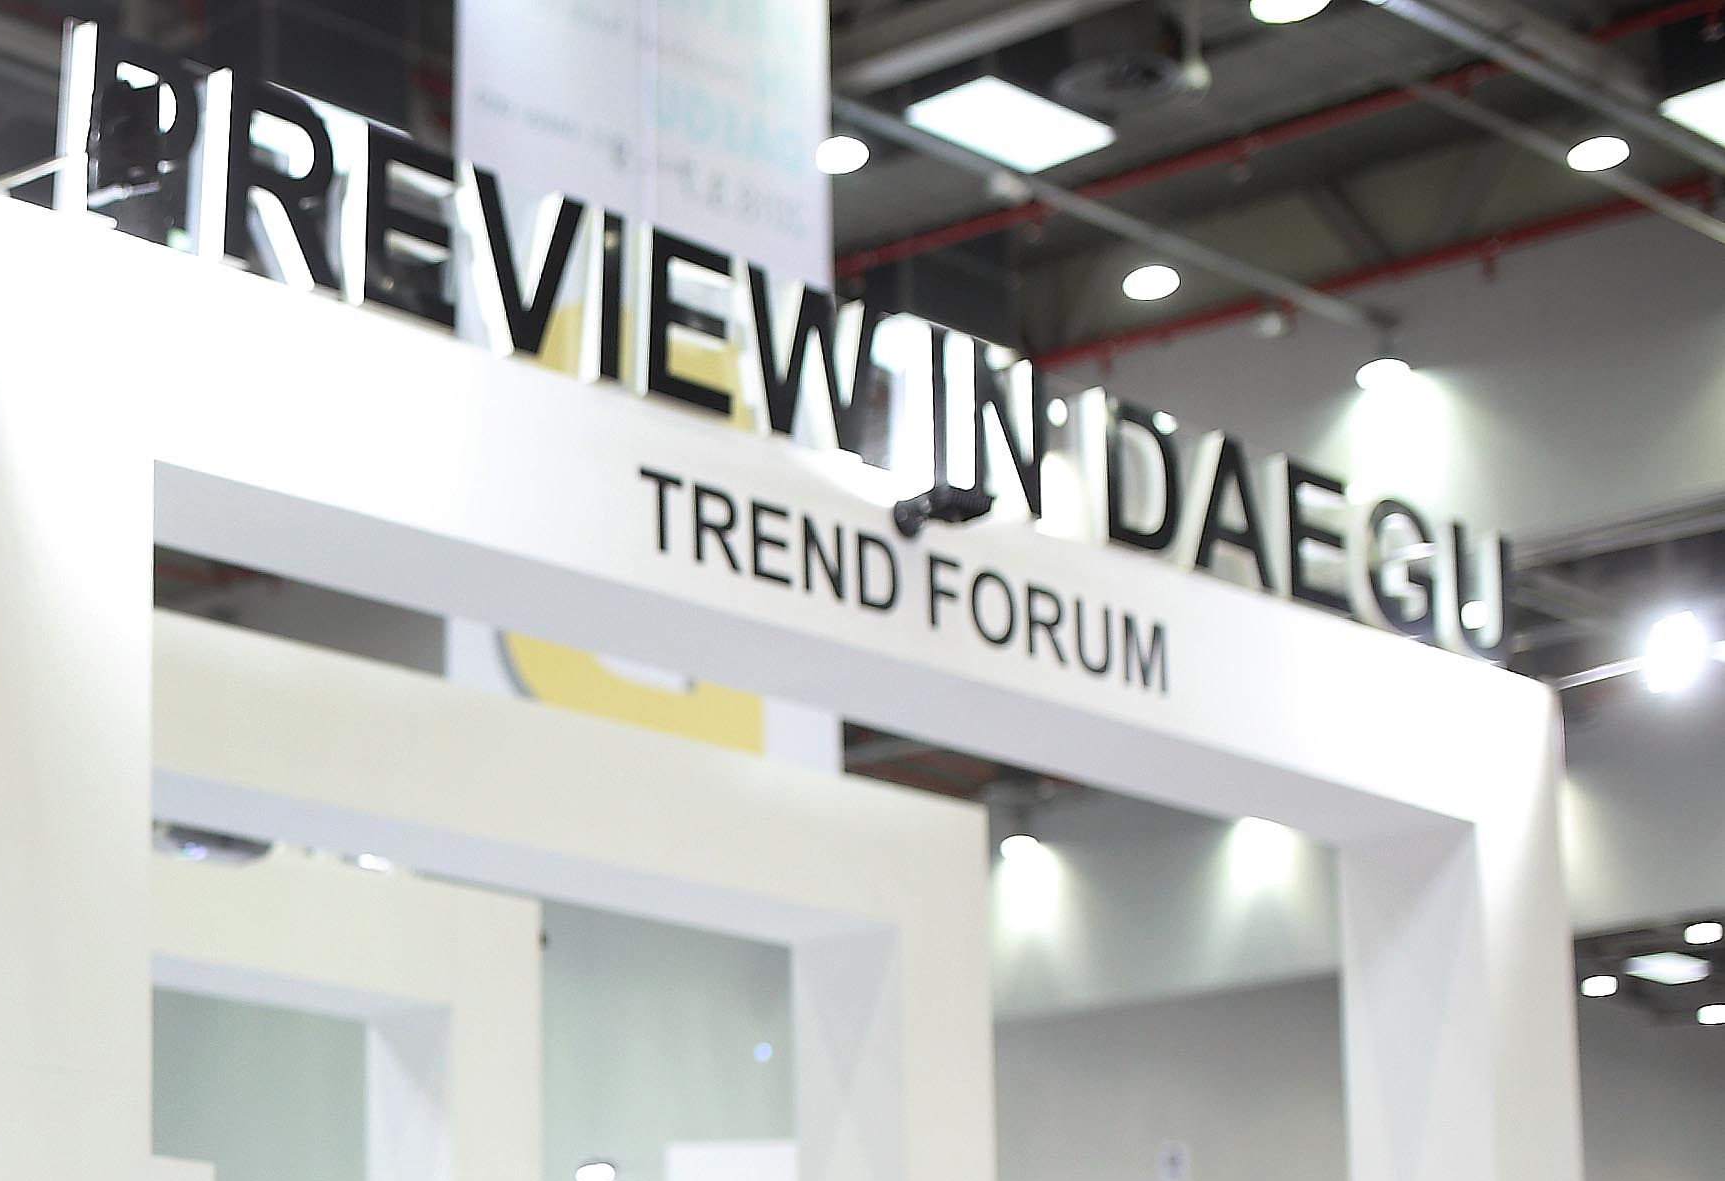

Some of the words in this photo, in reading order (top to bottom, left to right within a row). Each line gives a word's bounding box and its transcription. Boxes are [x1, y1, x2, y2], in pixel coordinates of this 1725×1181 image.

[59, 18, 872, 458] PREVIEW
[886, 312, 1047, 522] IN
[1079, 385, 1512, 668] DAEGU
[640, 466, 901, 614] TREND
[926, 553, 1171, 699] FORUM
